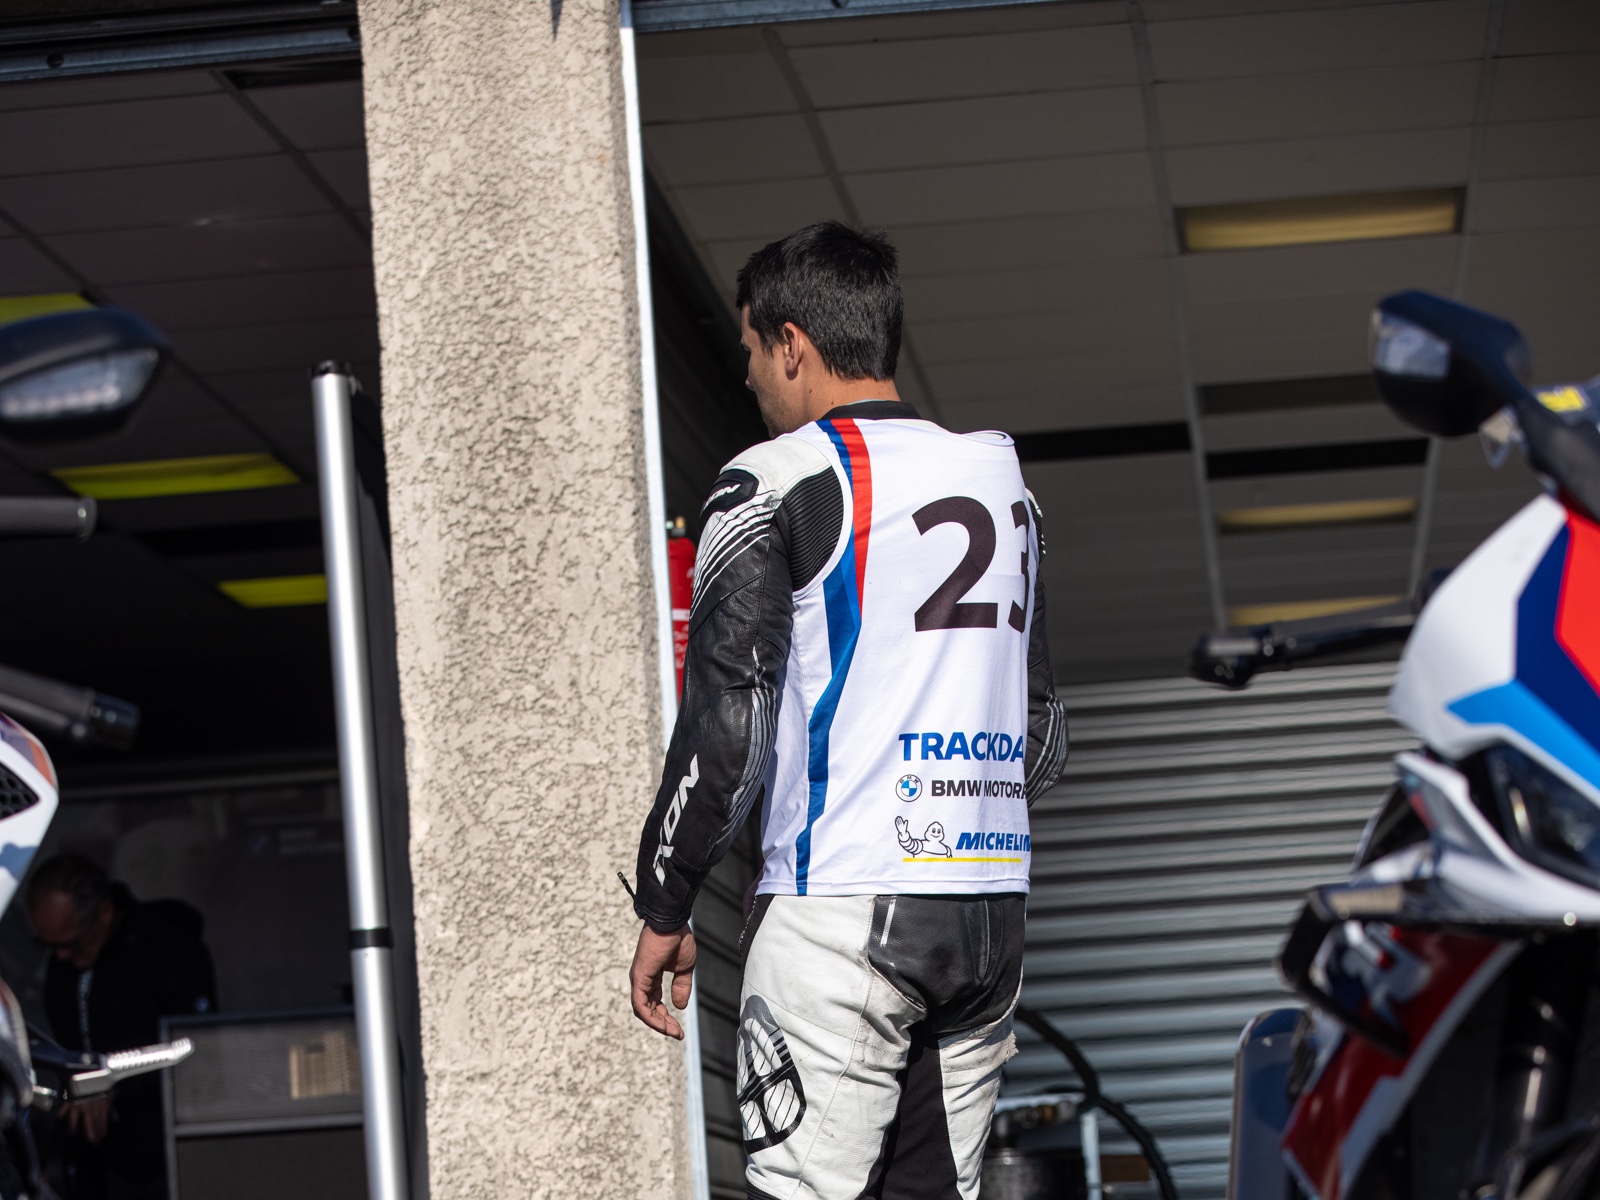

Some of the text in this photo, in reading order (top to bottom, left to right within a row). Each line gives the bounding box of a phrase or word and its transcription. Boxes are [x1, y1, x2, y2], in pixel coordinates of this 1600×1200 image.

[911, 496, 1030, 634] 23
[931, 780, 982, 797] BMW
[955, 832, 1032, 852] MICHELIN
